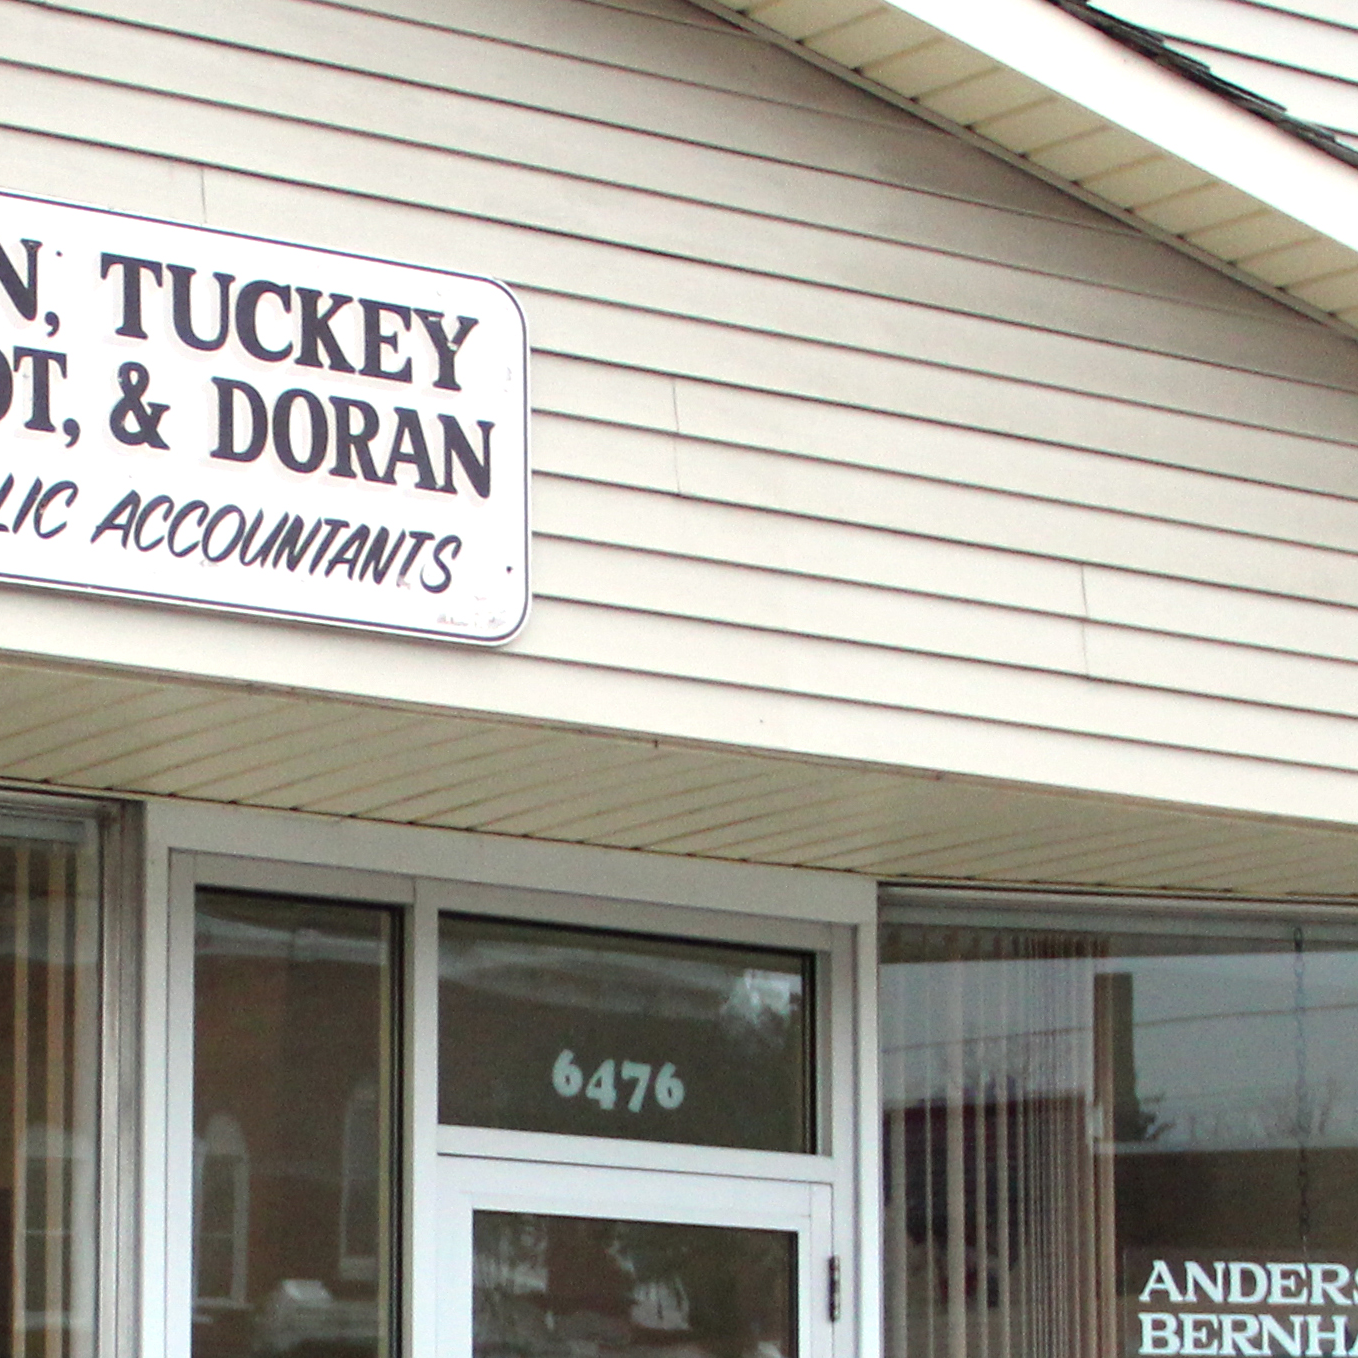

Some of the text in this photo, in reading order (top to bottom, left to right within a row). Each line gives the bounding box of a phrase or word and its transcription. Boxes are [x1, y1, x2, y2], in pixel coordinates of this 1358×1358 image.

[101, 252, 479, 393] TUCKEY
[108, 361, 170, 450] &
[209, 376, 495, 499] DORAN
[91, 489, 463, 594] ACCOUNTANTS
[551, 1049, 685, 1113] 6476
